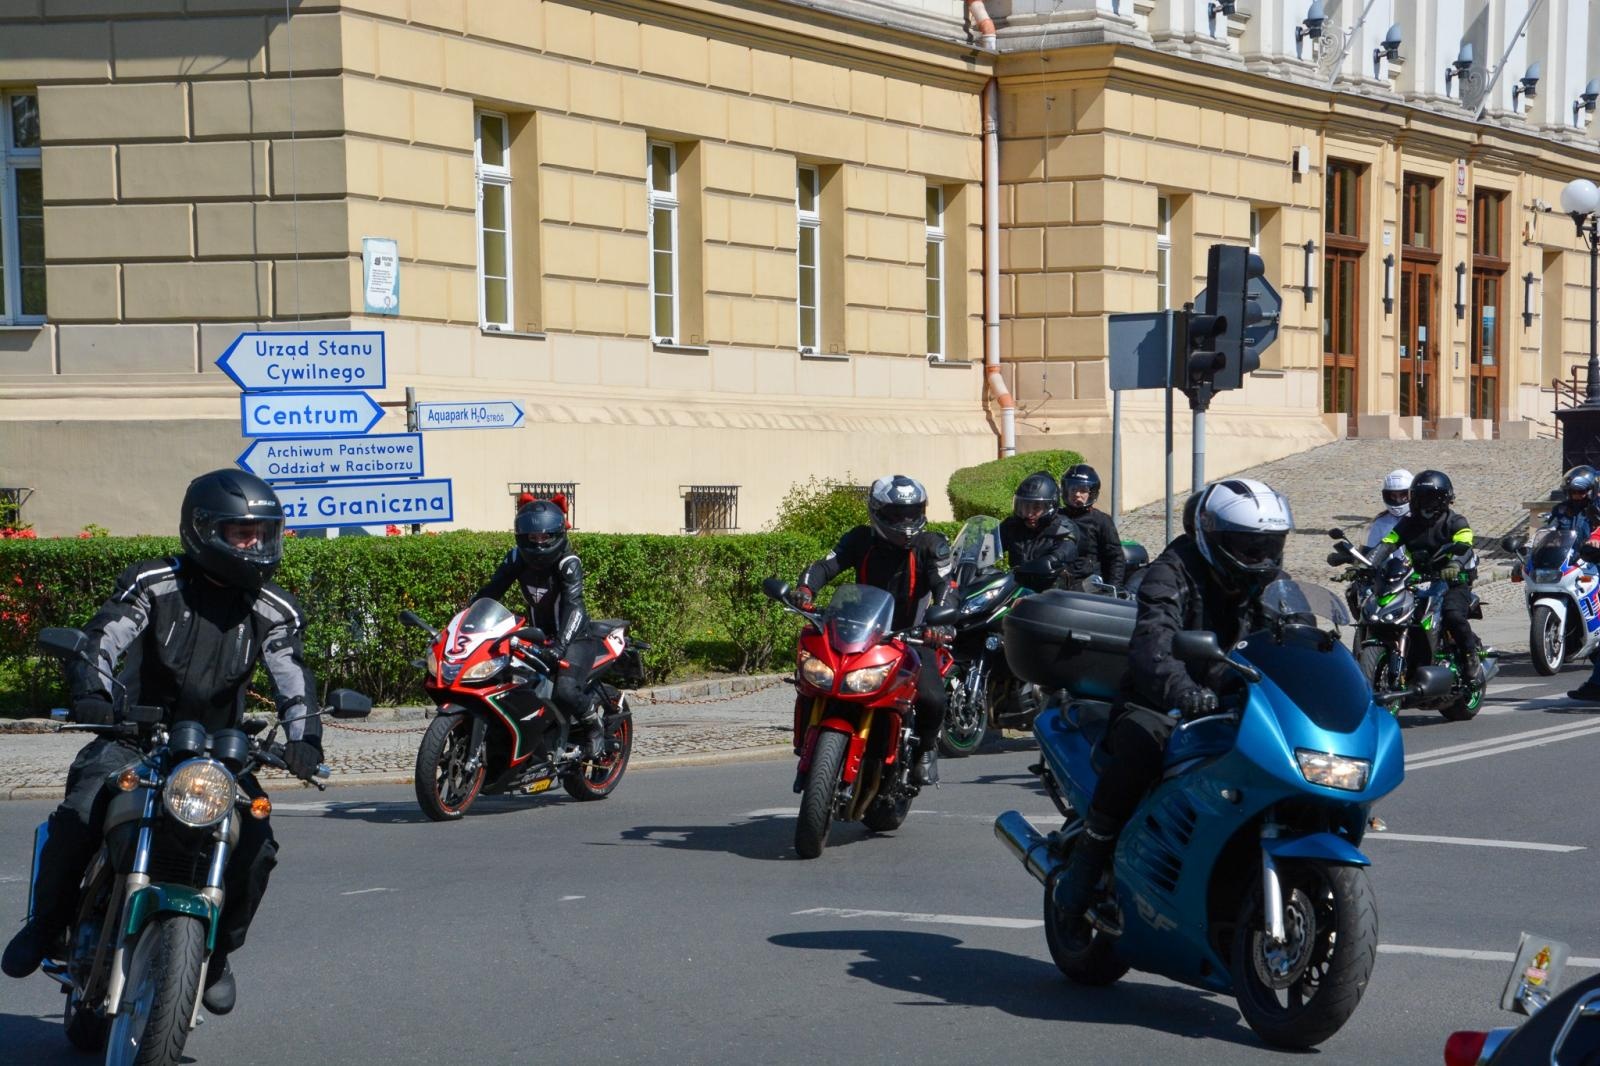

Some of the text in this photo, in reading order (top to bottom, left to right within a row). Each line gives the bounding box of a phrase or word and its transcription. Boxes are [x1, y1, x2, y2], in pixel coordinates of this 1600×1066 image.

[256, 340, 372, 360] Urząd Stanu
[267, 363, 365, 384] Cywilnego
[254, 404, 358, 425] Centrum
[428, 408, 469, 424] Aquapark
[267, 443, 414, 458] Archiwum Państwowe
[268, 460, 413, 474] Oddział w Raciborzu
[318, 493, 444, 516] Graniczna
